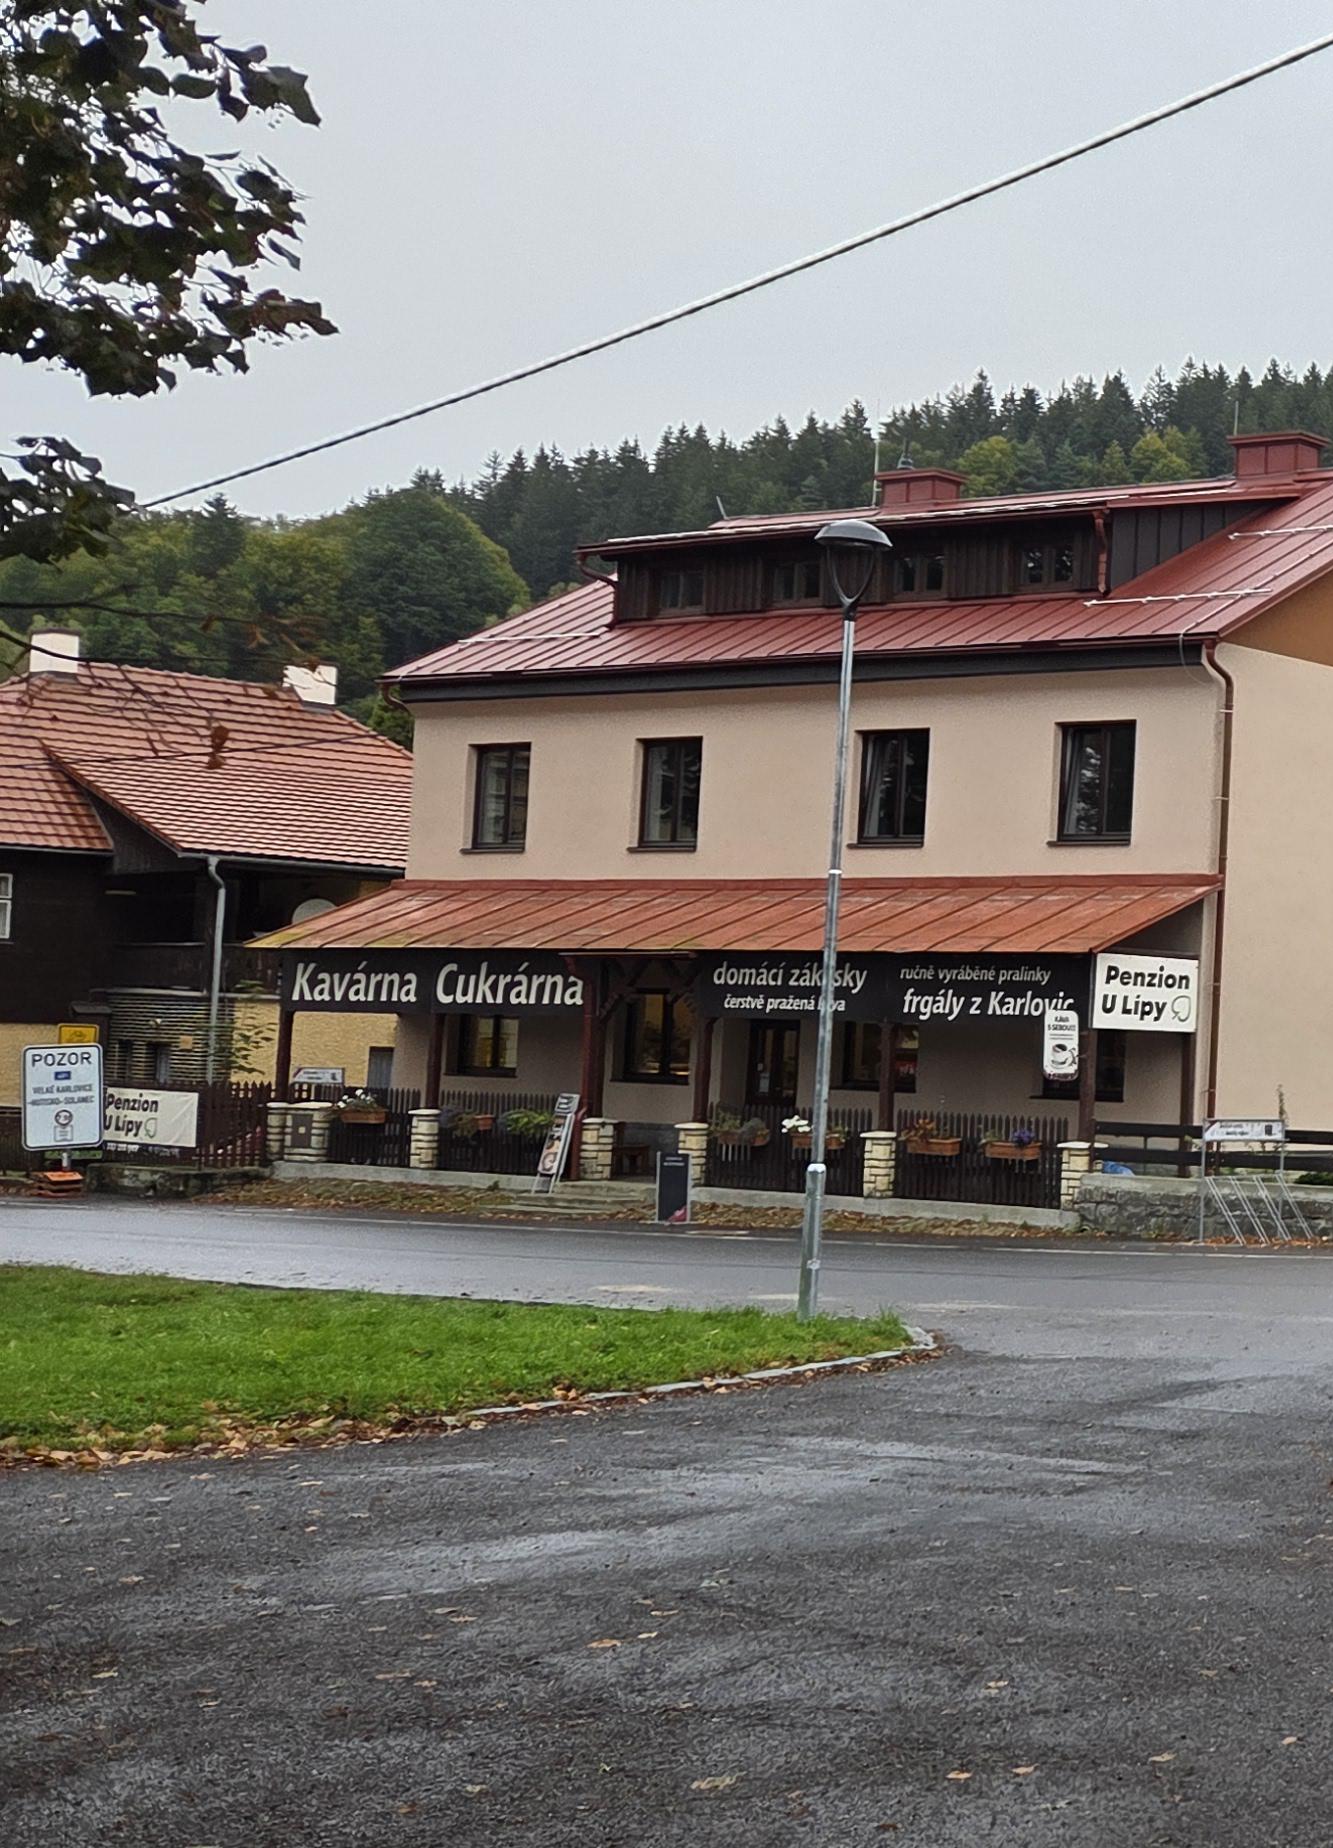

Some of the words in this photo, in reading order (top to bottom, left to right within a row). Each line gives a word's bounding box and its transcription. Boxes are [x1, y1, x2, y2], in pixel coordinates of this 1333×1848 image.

[291, 961, 417, 1002] Kavárna
[436, 961, 584, 1005] Cukrárna
[713, 961, 786, 985] domácí
[788, 962, 867, 994] záksky
[900, 965, 935, 980] ručně
[938, 965, 996, 984] vyráběné
[998, 966, 1051, 985] pralinky
[1105, 965, 1190, 990] Penzion
[723, 994, 765, 1010] čerstvě
[766, 995, 815, 1013] pražená
[902, 988, 965, 1021] frgály
[969, 997, 982, 1014] z
[1101, 994, 1117, 1014] U
[1121, 995, 1168, 1022] Lípy
[31, 1051, 92, 1067] POZOR
[106, 1092, 159, 1112] Penzion
[115, 1114, 143, 1138] Lípy
